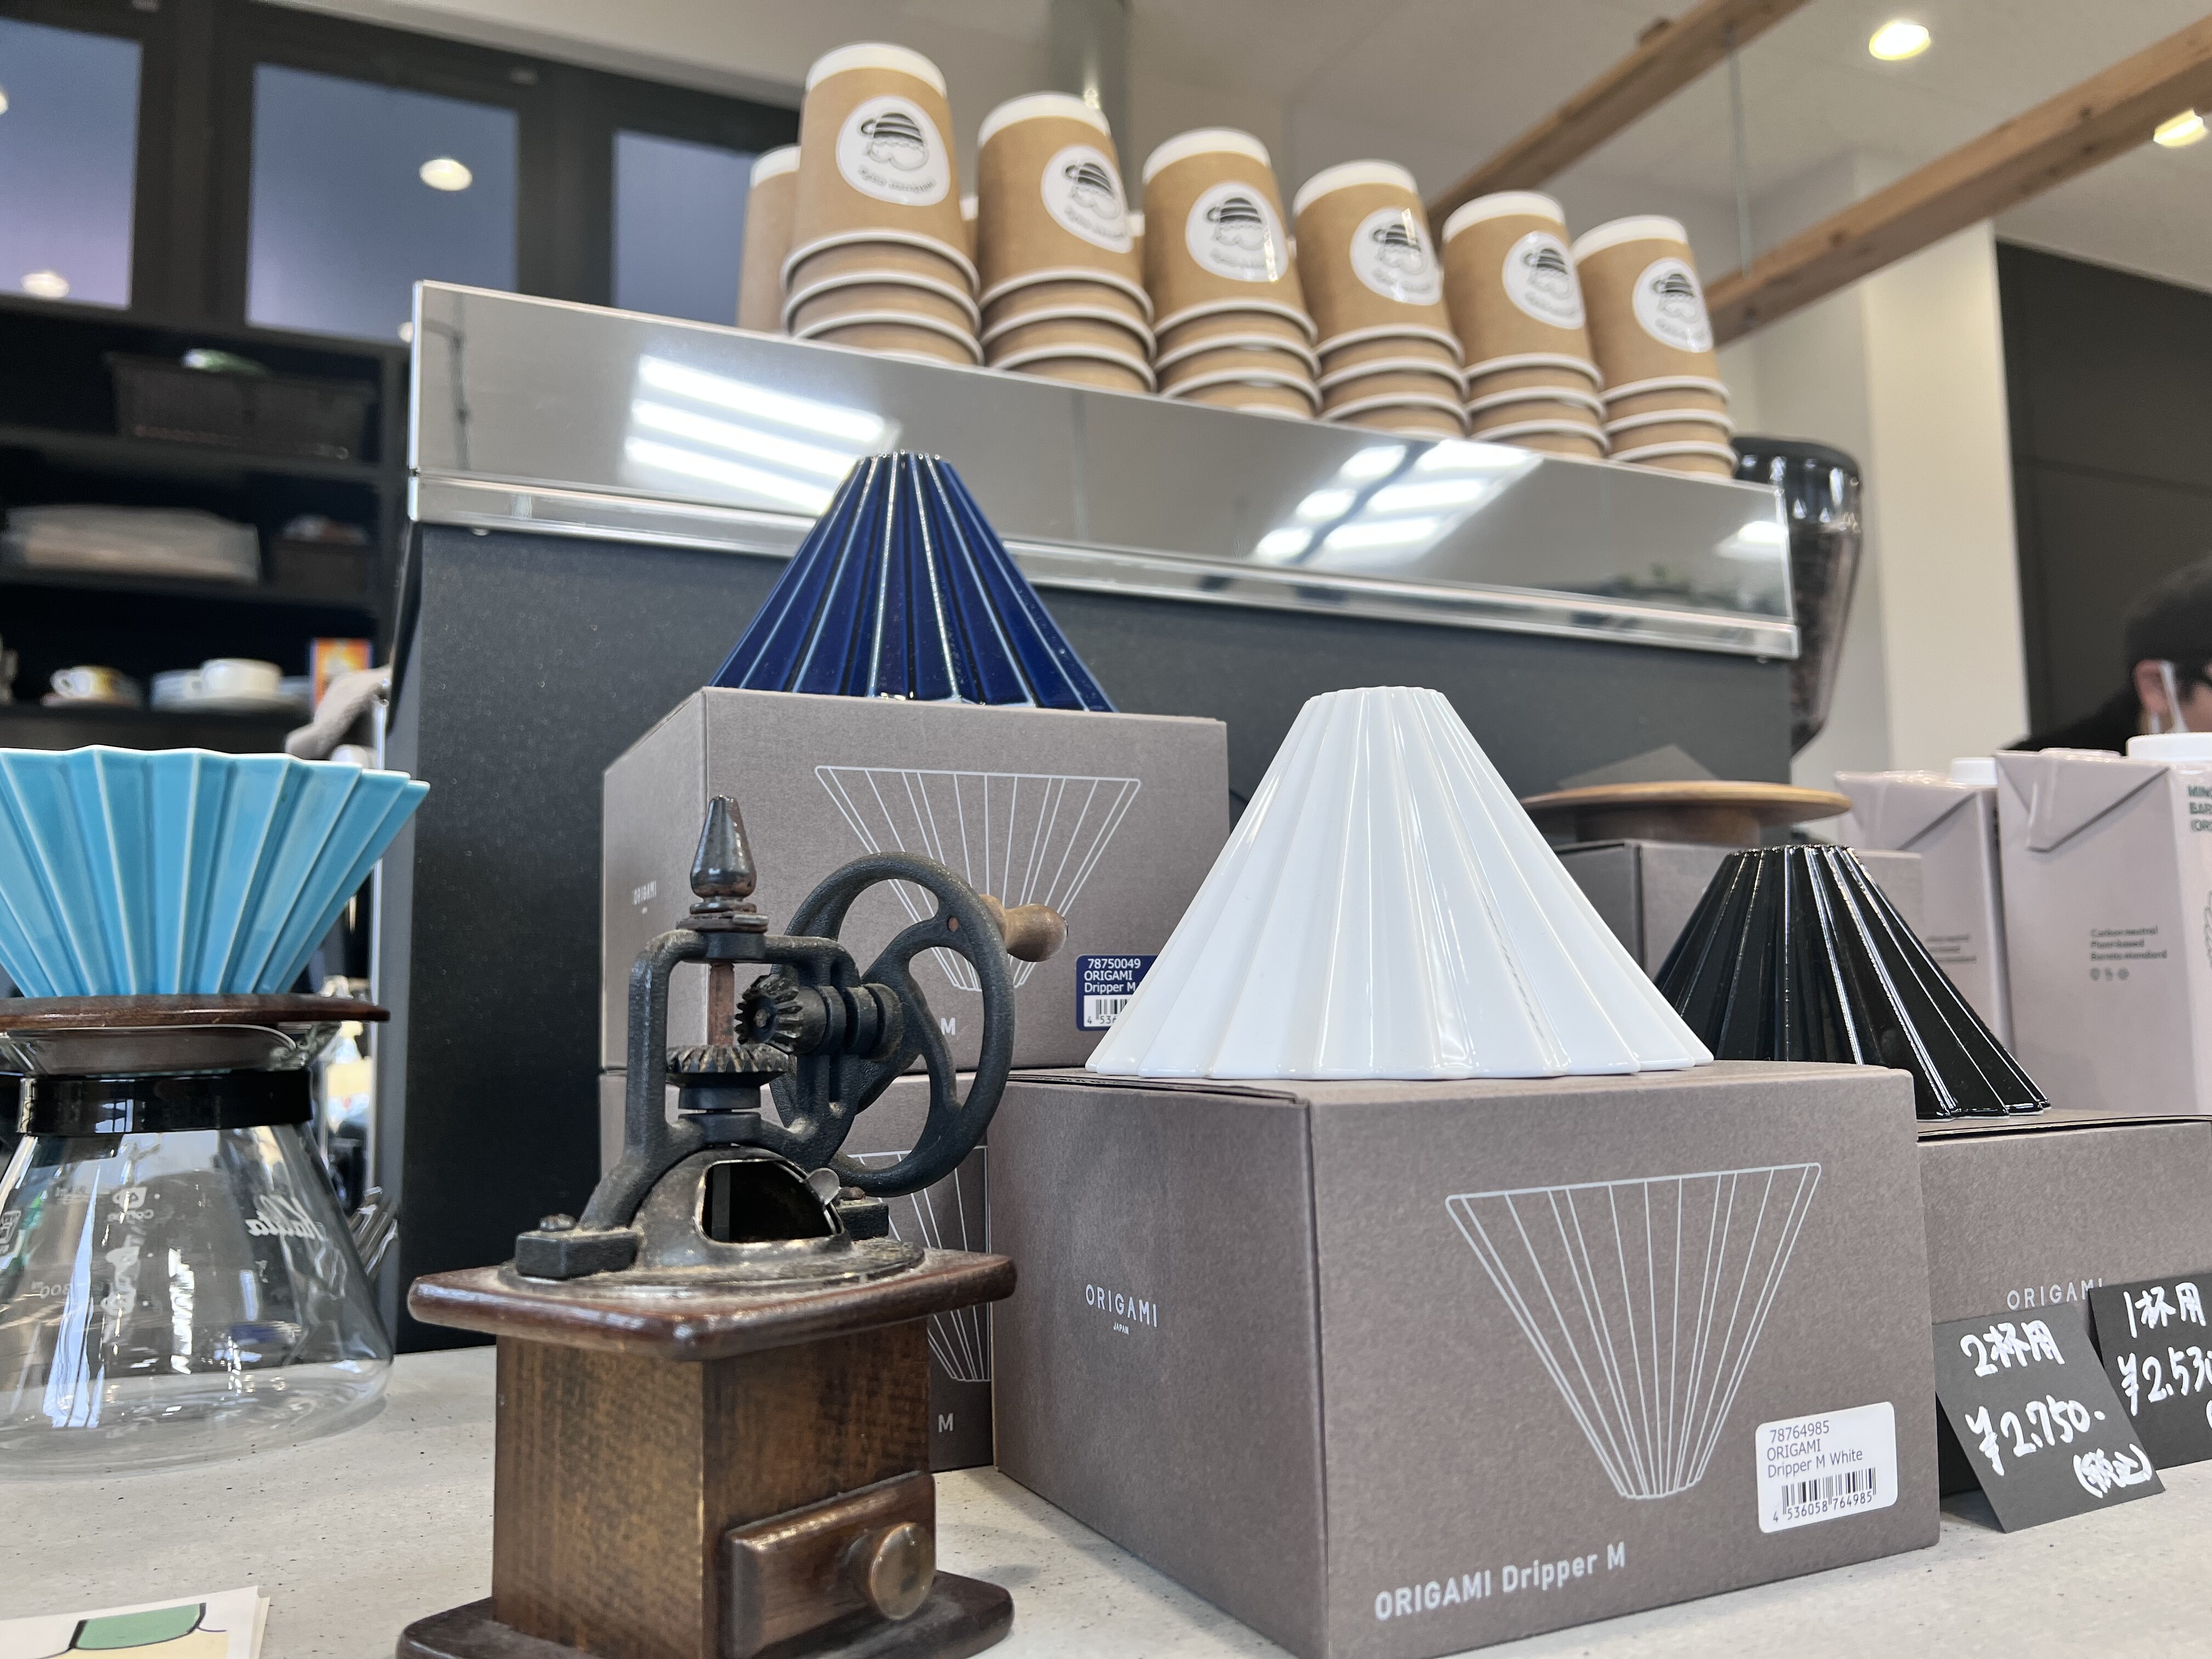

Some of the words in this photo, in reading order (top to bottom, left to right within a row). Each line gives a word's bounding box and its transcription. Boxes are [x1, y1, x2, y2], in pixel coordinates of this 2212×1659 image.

[633, 880, 657, 905] ORIGAMI
[1084, 970, 1133, 981] ORIGAMI
[1087, 958, 1141, 969] 78750049
[1084, 981, 1124, 994] Dripper
[1126, 981, 1136, 992] M
[940, 1017, 956, 1035] M
[1085, 1284, 1158, 1328] ORIGAMI
[1113, 1322, 1130, 1335] JAPAN
[1960, 1319, 2066, 1378] 2杯用
[938, 1413, 954, 1433] M
[1770, 1420, 1830, 1444] 78764985
[1767, 1438, 1821, 1462] ORIGAMI
[1768, 1459, 1812, 1479] Dripper
[1816, 1454, 1826, 1469] M
[1829, 1448, 1863, 1466] White
[1773, 1511, 1779, 1523] 4
[1787, 1500, 1829, 1520] 536058
[1832, 1491, 1872, 1510] 764985
[1375, 1569, 1491, 1621] ORIGAMI
[1502, 1553, 1598, 1591] Dripper
[1607, 1541, 1626, 1571] M
